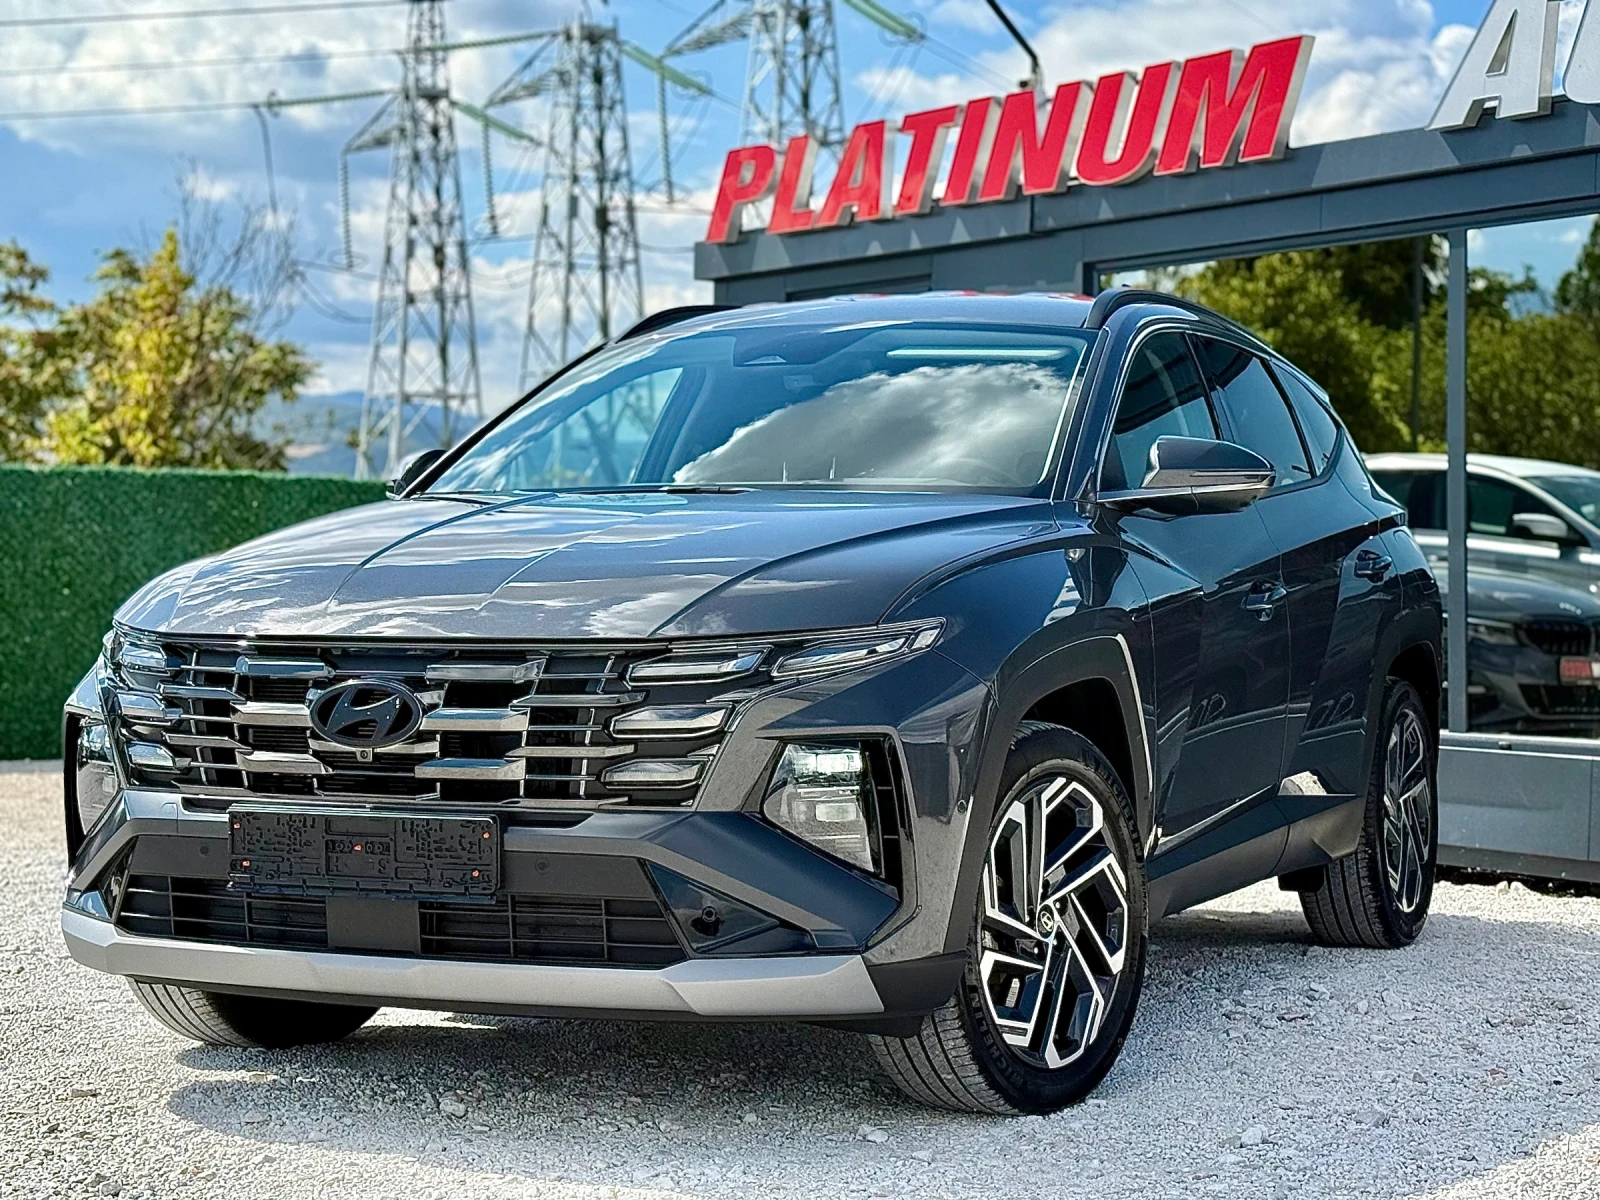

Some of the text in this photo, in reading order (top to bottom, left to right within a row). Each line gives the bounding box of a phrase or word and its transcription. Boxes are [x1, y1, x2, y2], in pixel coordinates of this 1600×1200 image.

[706, 35, 1314, 243] PLATINUM
[1098, 764, 1143, 858] MICHELIN
[970, 991, 1023, 1091] MICHELIN
